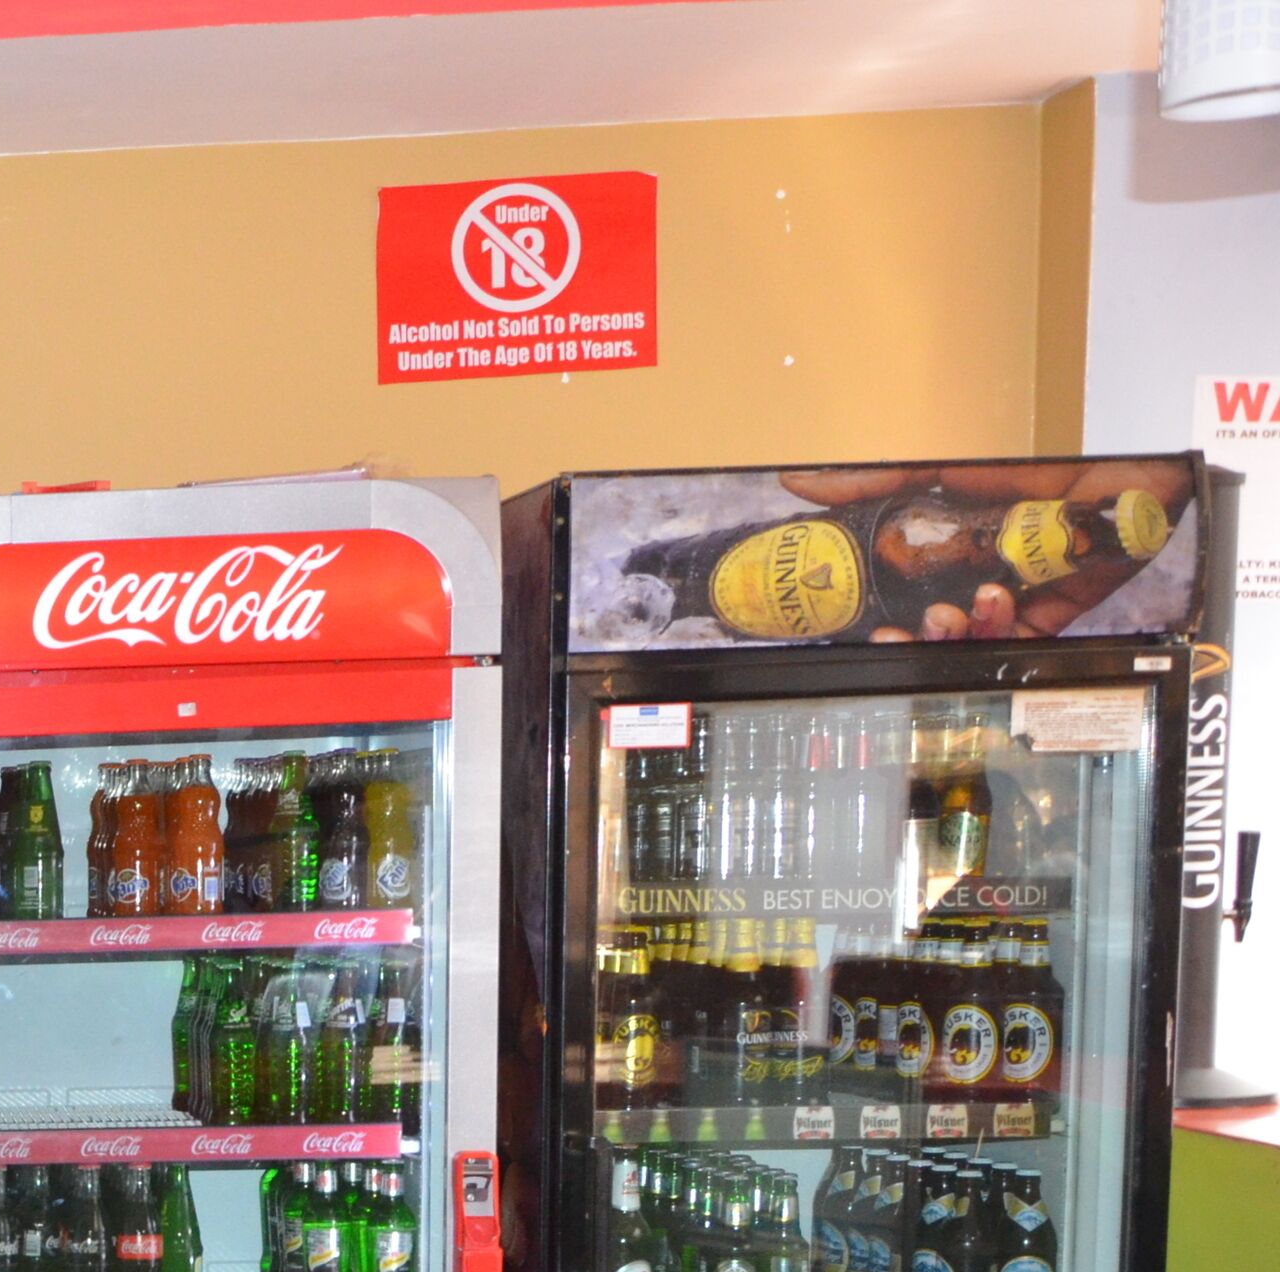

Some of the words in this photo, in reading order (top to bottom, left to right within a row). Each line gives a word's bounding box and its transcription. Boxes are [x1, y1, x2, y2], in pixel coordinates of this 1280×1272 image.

[495, 204, 549, 224] Under
[481, 227, 545, 289] 18
[388, 321, 459, 344] Alcohol
[463, 319, 494, 339] Not
[497, 315, 539, 338] Sold
[543, 314, 565, 335] To
[569, 311, 645, 333] Persons
[397, 351, 454, 372] Under
[457, 348, 490, 368] The
[494, 346, 530, 367] Age
[533, 343, 554, 363] Of
[557, 340, 577, 361] 18
[581, 339, 637, 359] Years.
[1215, 430, 1236, 439] ITS
[1240, 430, 1258, 439] AN
[775, 524, 811, 635] GUINNESS
[33, 544, 344, 650] Coca-Cola
[1182, 693, 1228, 909] GUINNESS
[618, 886, 746, 914] GUINNESS
[763, 889, 813, 911] BEST
[822, 887, 926, 910] ENJOYD
[977, 885, 1048, 906] COLD!
[90, 923, 153, 946] Coca-Cola
[202, 920, 267, 944] Coca-Cola
[313, 917, 380, 940] Coca-Cola
[943, 1011, 992, 1038] TUSKER
[863, 1113, 899, 1129] Pilsner
[929, 1112, 966, 1129] Pilsner
[996, 1112, 1033, 1128] Pilsner
[80, 1135, 144, 1158] Coca-Cola
[191, 1132, 256, 1155] Coca-Cola
[302, 1131, 367, 1153] Coca-Cola
